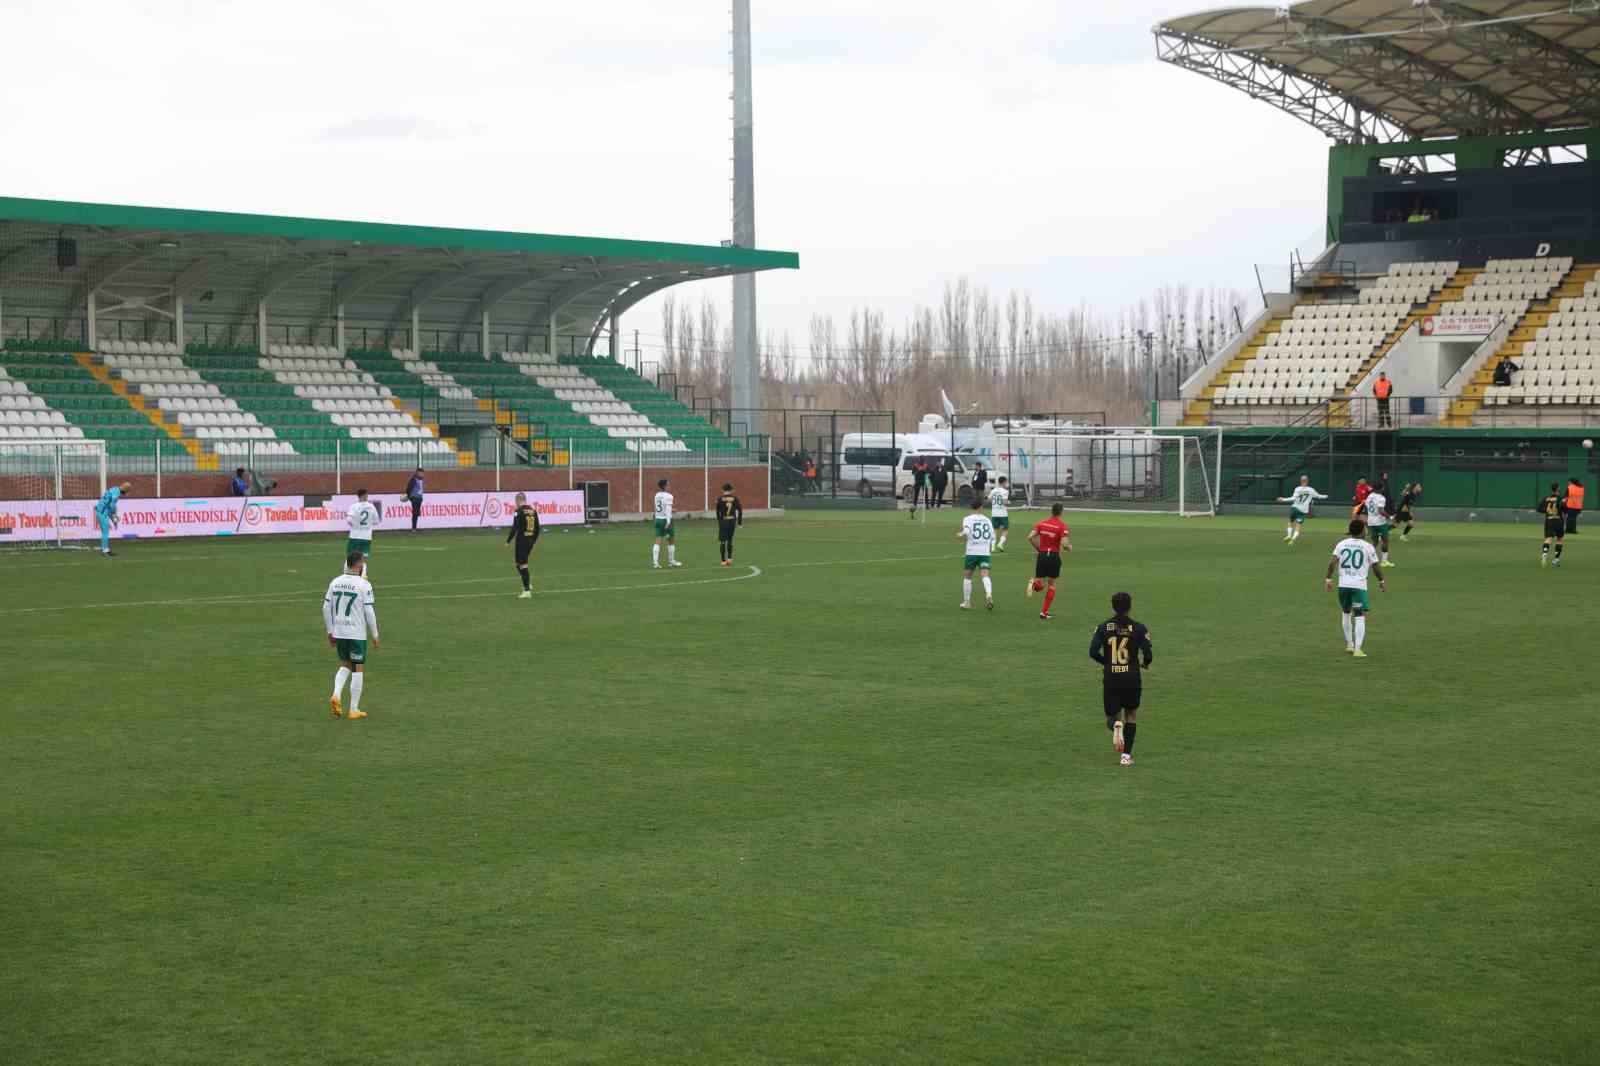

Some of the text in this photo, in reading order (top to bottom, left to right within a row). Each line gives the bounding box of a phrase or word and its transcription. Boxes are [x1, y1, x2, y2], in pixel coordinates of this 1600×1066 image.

[1536, 243, 1551, 257] D
[18, 512, 54, 528] Tavuk
[121, 511, 157, 525] AYDIN
[265, 507, 298, 522] Tavada
[299, 506, 329, 521] Tavuk
[360, 510, 369, 526] 2
[972, 522, 991, 540] 58
[1340, 548, 1364, 569] 20
[332, 591, 358, 616] 77
[1108, 636, 1129, 665] 16
